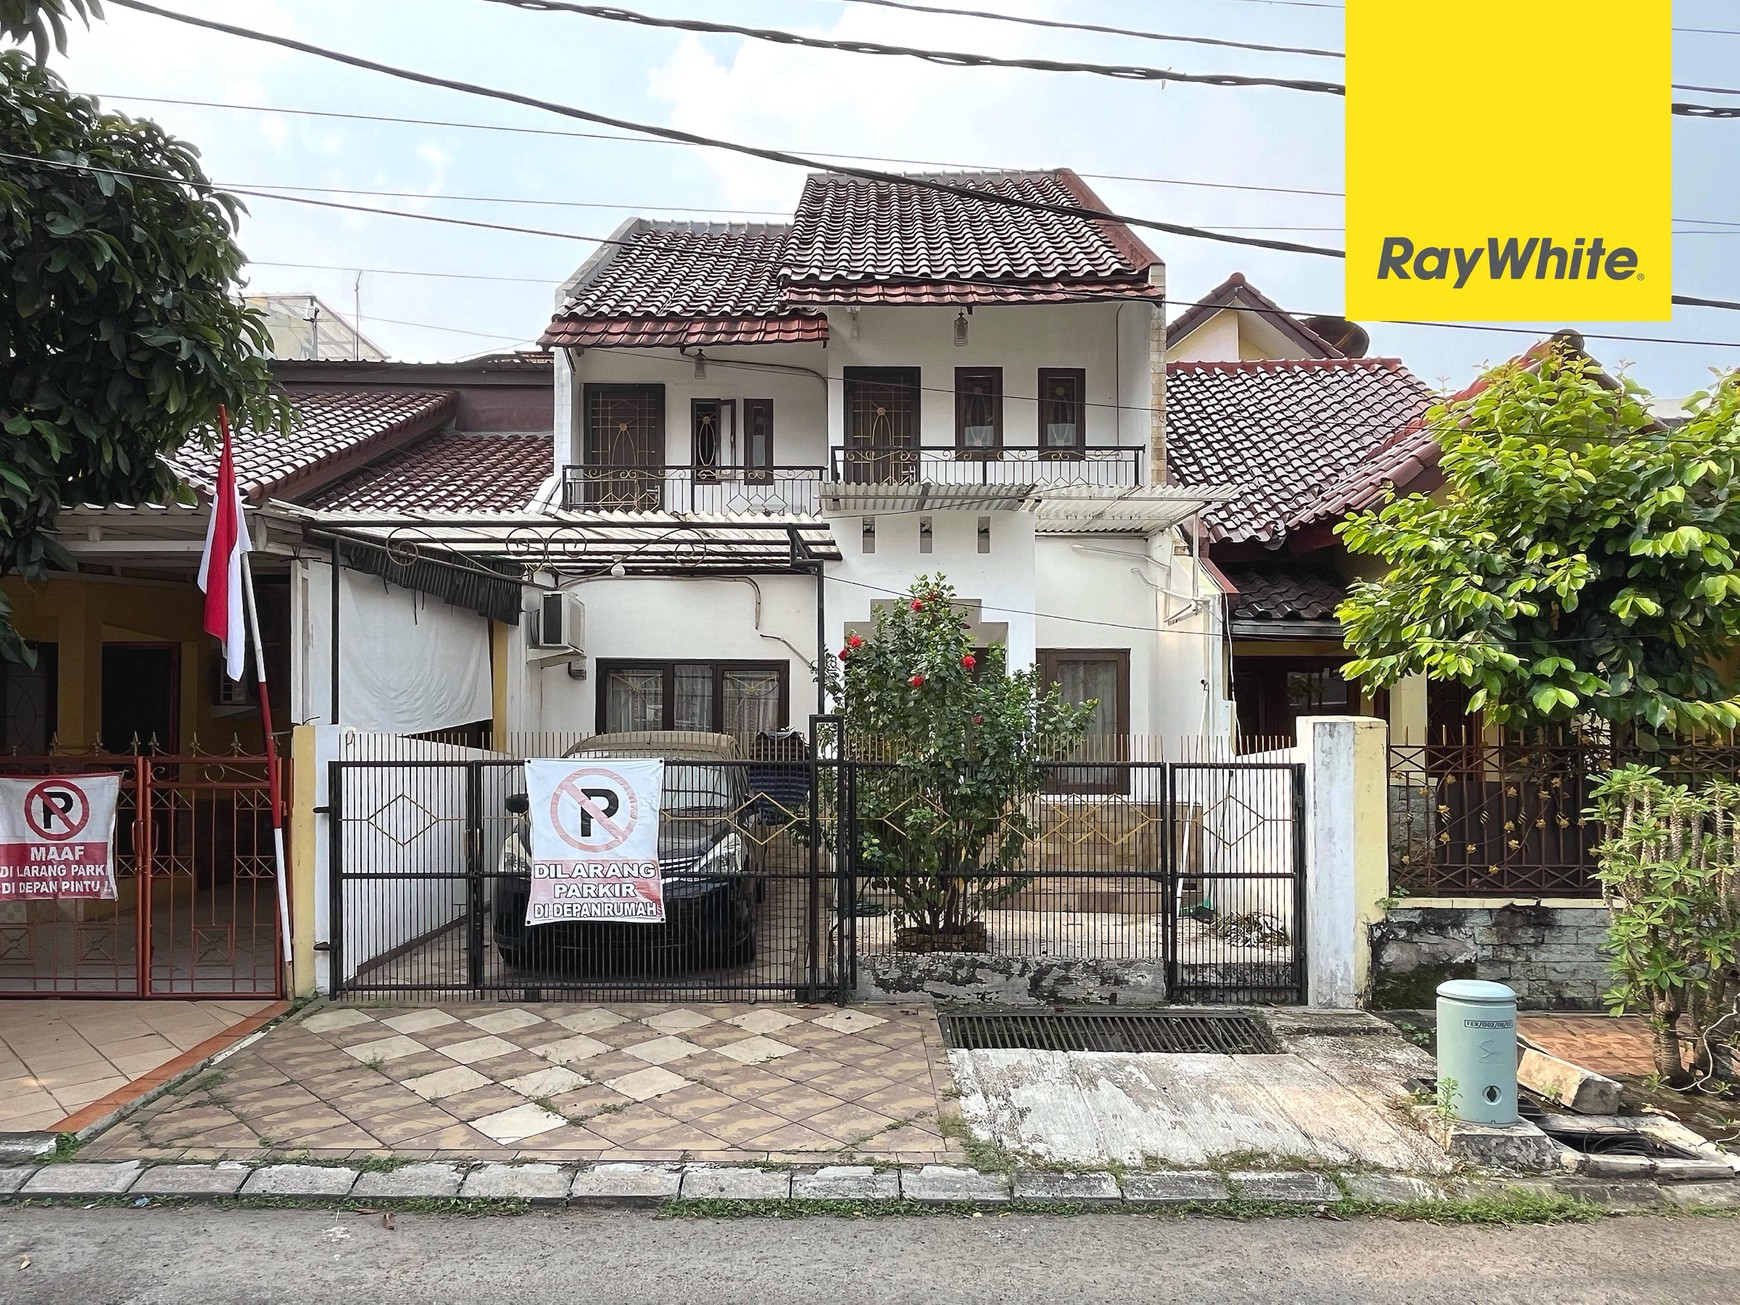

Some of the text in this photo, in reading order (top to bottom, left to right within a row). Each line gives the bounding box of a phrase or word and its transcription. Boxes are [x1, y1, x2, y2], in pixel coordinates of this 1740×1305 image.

[30, 846, 85, 861] MAAF
[0, 866, 13, 878] DI
[17, 865, 67, 877] LARANG
[534, 863, 657, 879] DILARANG
[1, 882, 15, 894] DI
[20, 881, 57, 893] DEPAN
[61, 881, 100, 892] PINTU
[554, 883, 637, 898] PARKIR
[534, 903, 549, 918] DI
